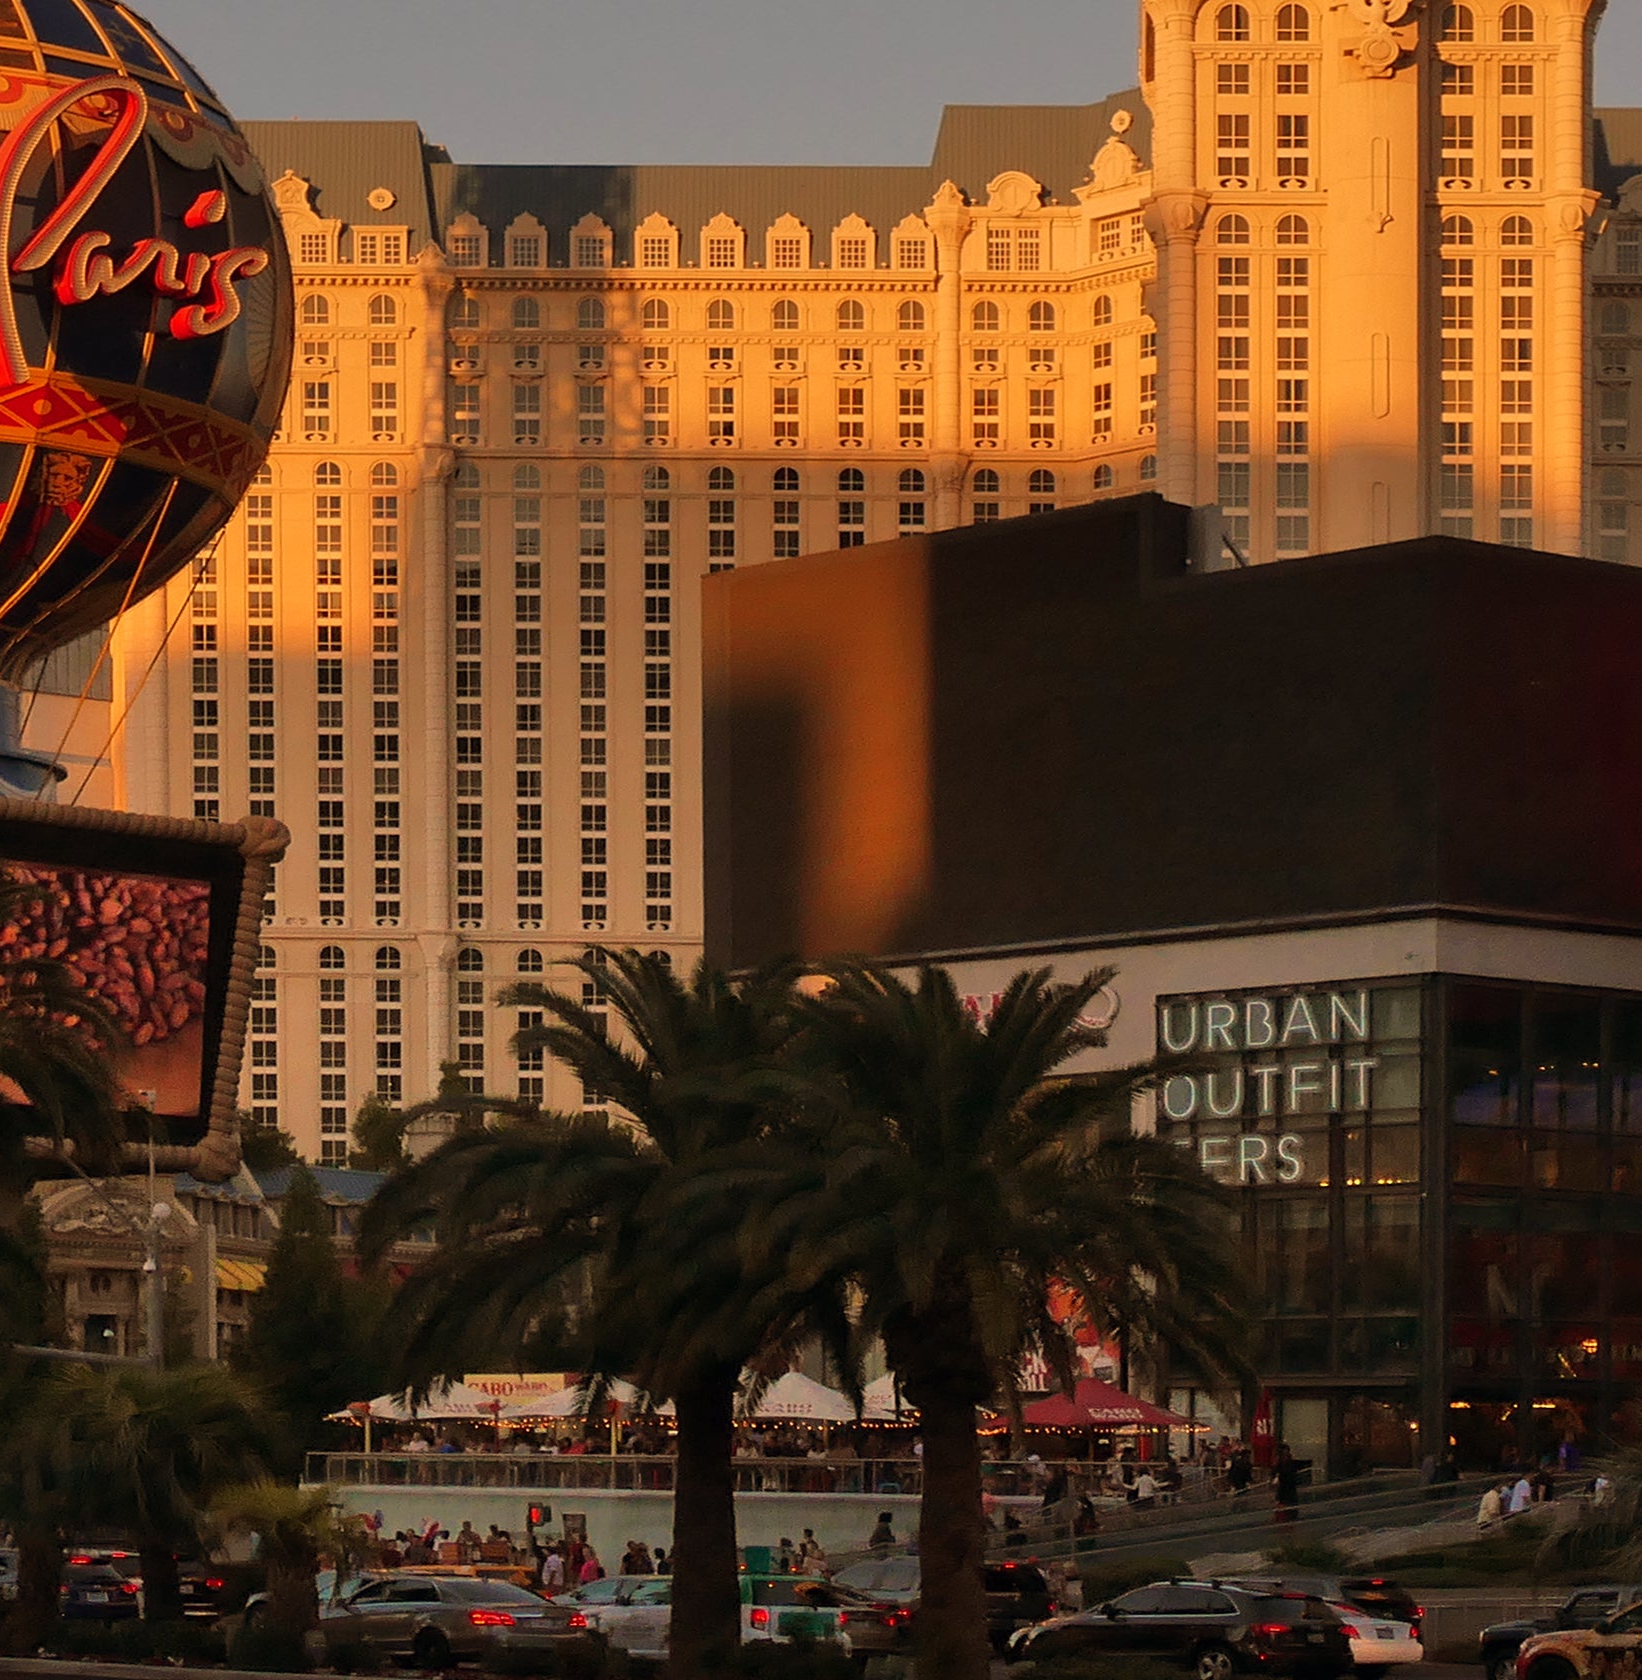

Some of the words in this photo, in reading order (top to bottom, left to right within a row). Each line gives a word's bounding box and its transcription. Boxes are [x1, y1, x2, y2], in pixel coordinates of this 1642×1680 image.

[1162, 991, 1367, 1052] URBAN
[1163, 1060, 1378, 1118] OUTFIT
[1173, 1134, 1301, 1182] ERS
